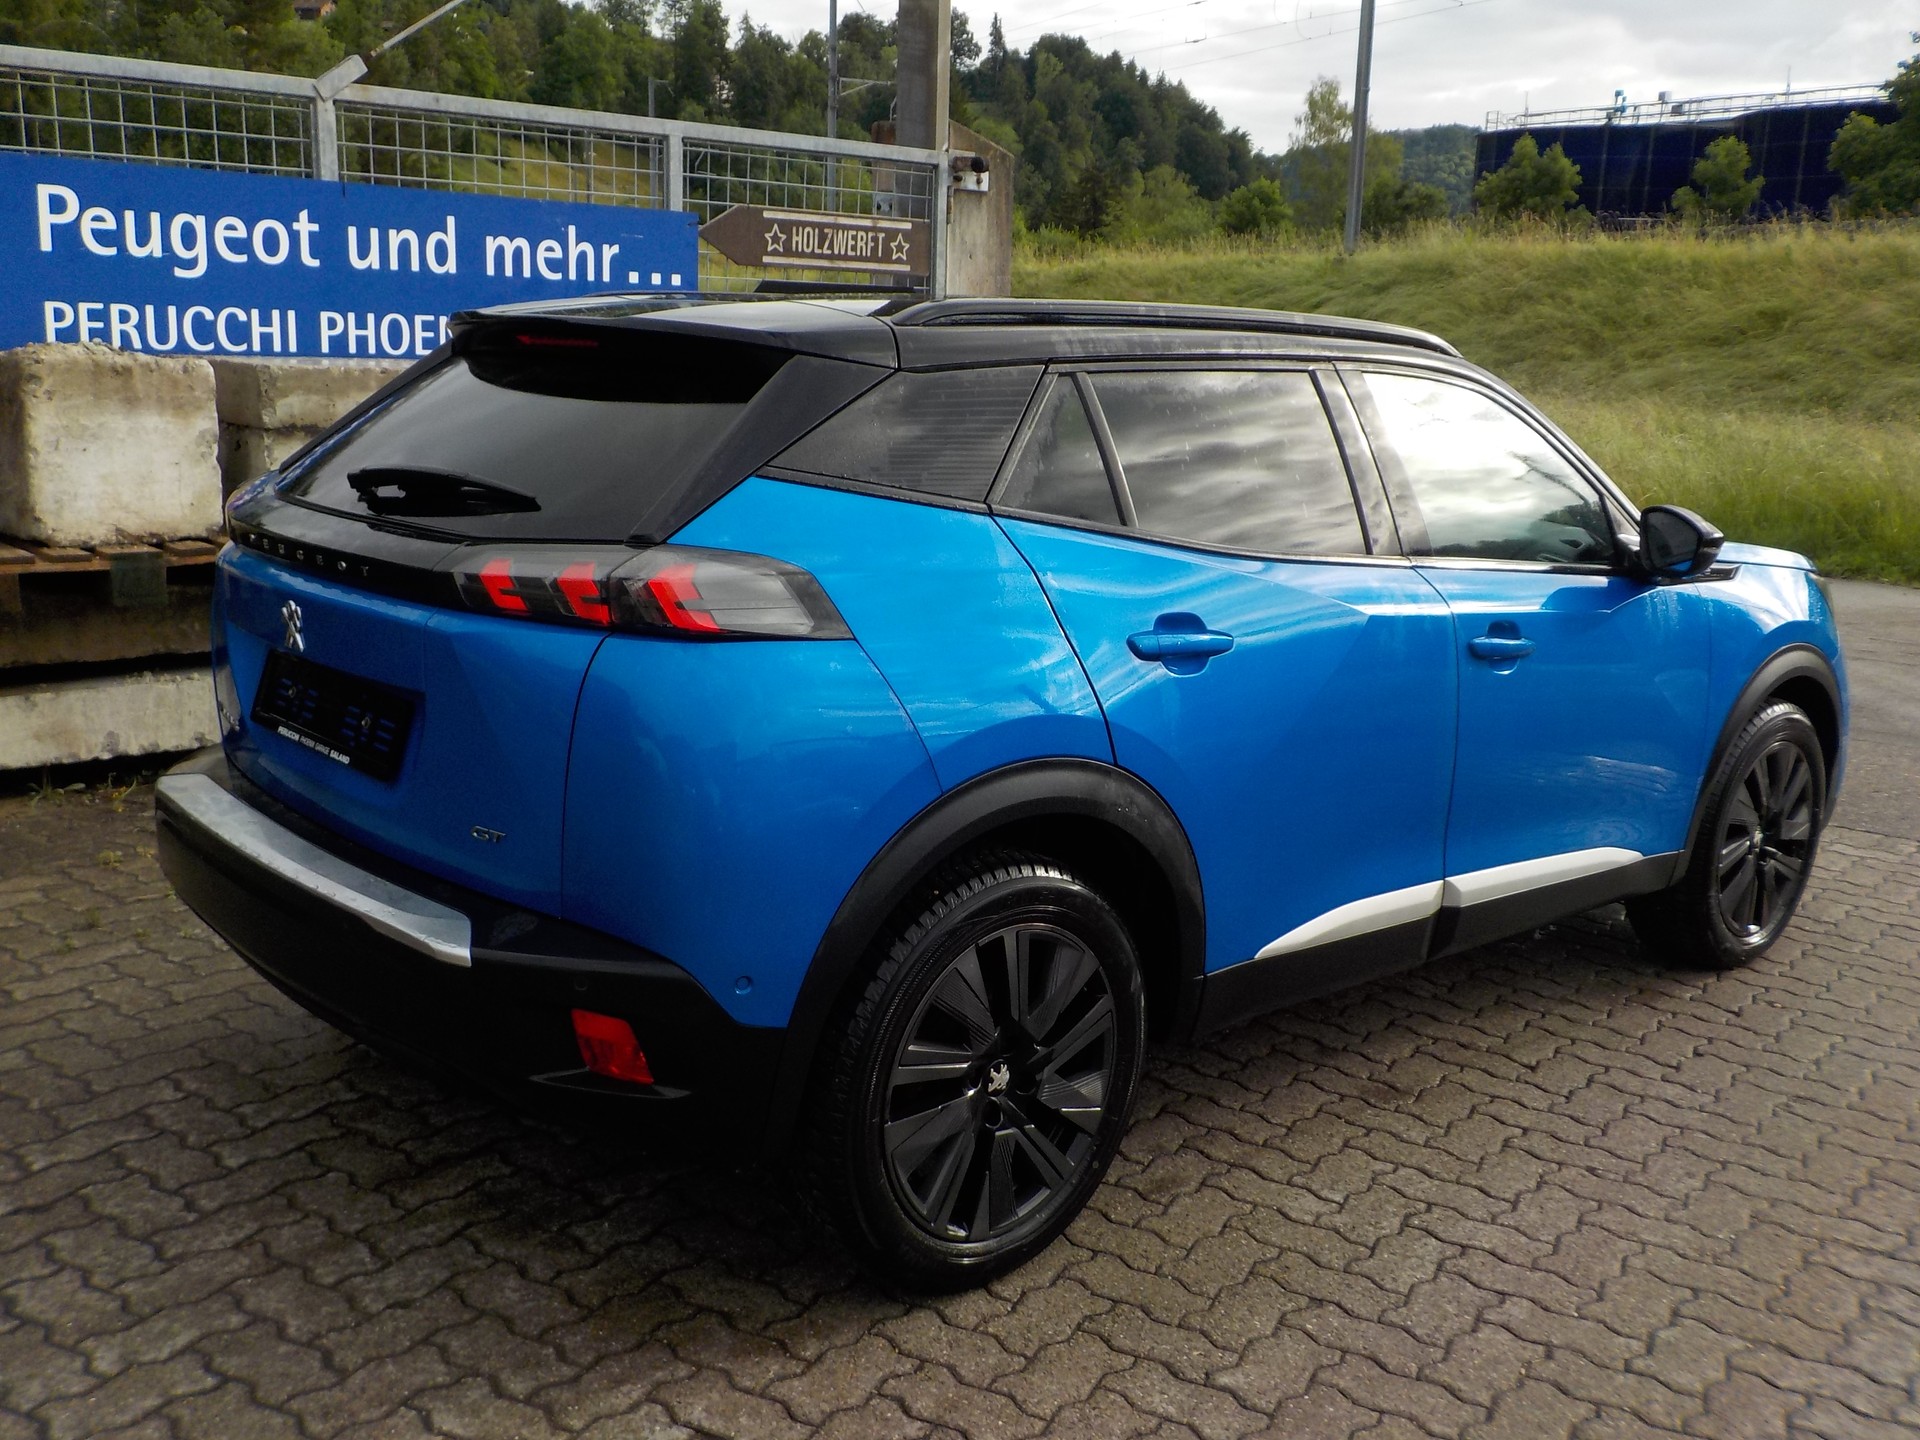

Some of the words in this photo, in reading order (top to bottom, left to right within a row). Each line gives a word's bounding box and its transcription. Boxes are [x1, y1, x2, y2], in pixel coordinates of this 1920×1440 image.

[37, 183, 321, 278] Peugeot
[347, 216, 456, 273] und
[792, 226, 885, 258] HOLZWERFT
[44, 301, 298, 353] PERUCCHI
[249, 534, 369, 577] PEUGEOT
[472, 825, 507, 843] GT
